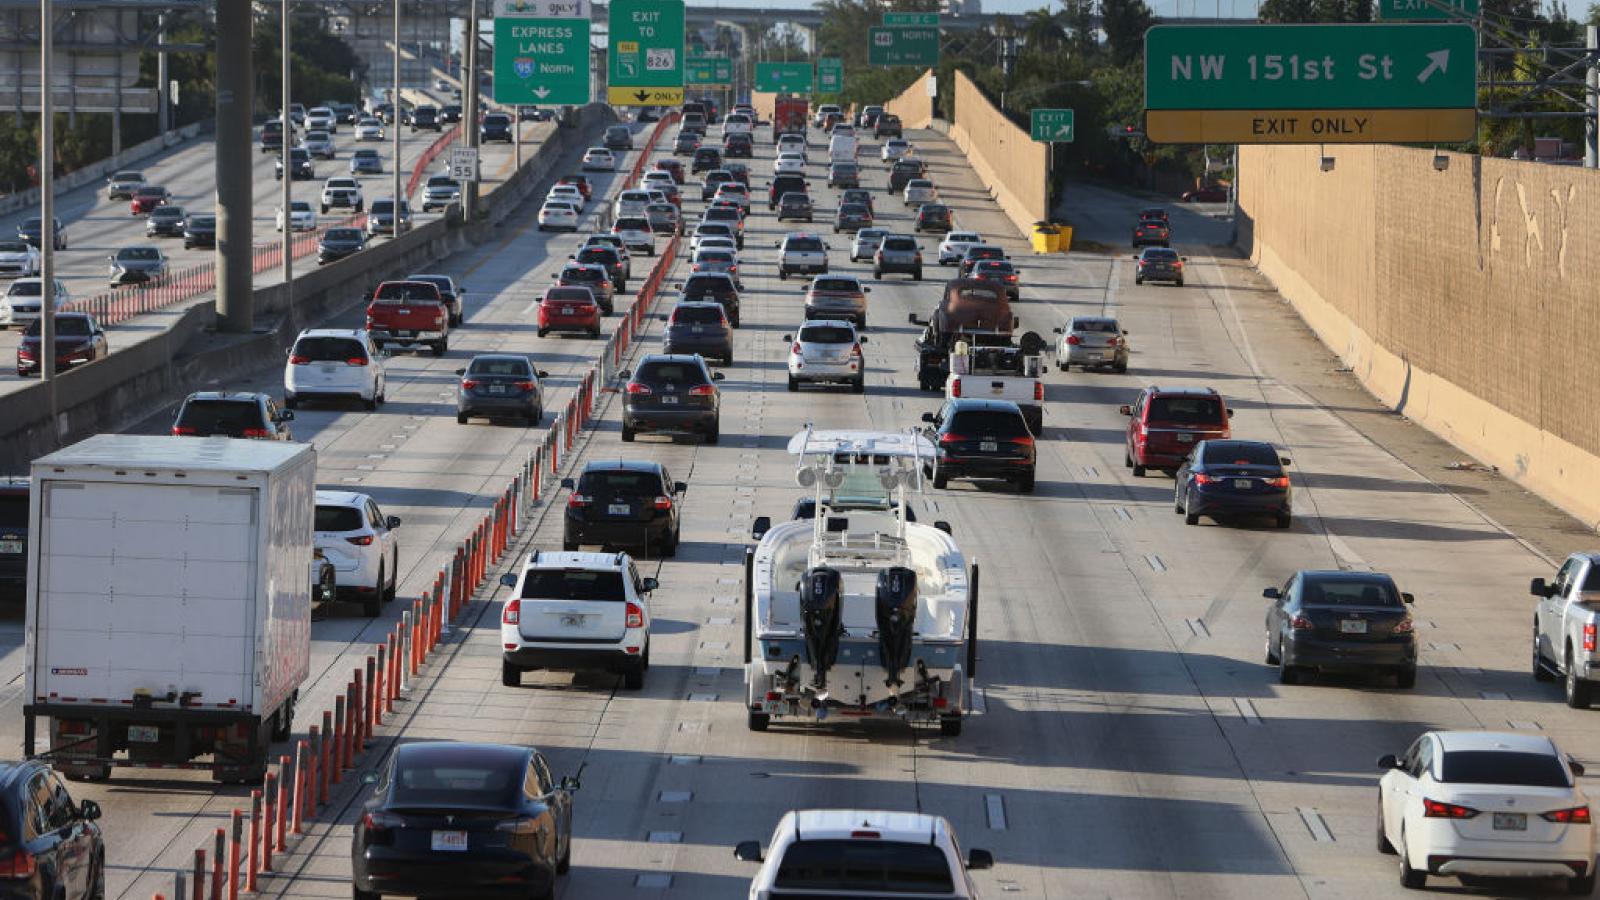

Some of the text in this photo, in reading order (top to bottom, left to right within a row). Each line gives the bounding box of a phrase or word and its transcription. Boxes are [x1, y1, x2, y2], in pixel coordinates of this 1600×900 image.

[1393, 0, 1430, 10] EXIT
[632, 11, 660, 22] EXIT
[511, 26, 573, 38] EXPRESS
[639, 26, 655, 37] TO
[902, 31, 934, 40] NORTH
[519, 42, 565, 54] LANES
[647, 56, 669, 68] 826
[1170, 54, 1394, 81] NW 151st St
[517, 62, 575, 74] 95 NORTH
[654, 93, 681, 101] ONLY
[1039, 113, 1065, 122] EXIT
[1039, 125, 1050, 137] 11
[1252, 118, 1368, 135] EXIT ONLY
[453, 166, 473, 177] 55
